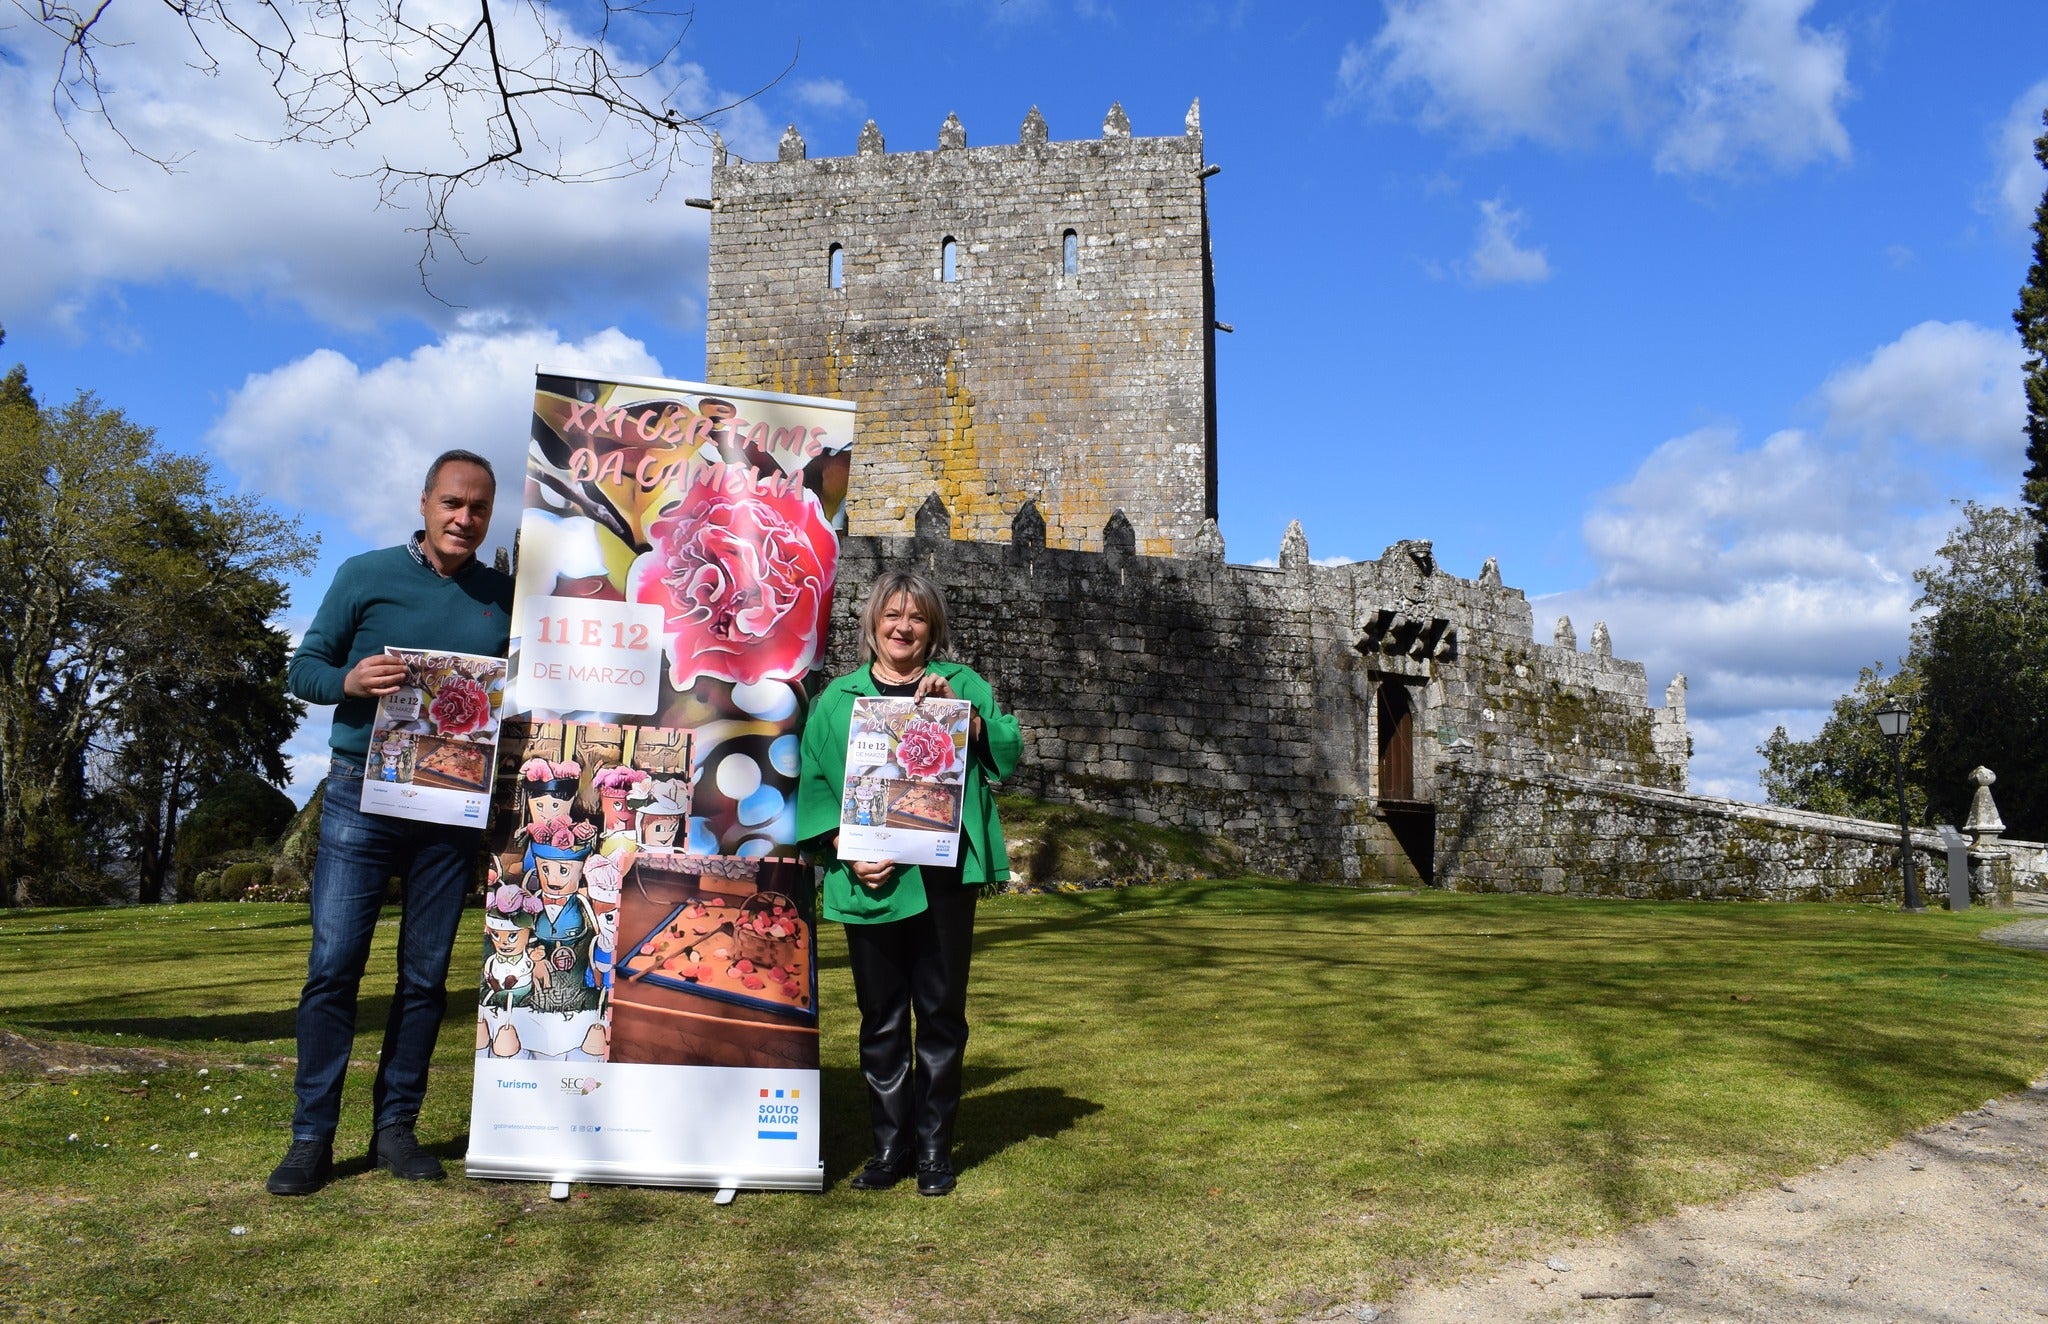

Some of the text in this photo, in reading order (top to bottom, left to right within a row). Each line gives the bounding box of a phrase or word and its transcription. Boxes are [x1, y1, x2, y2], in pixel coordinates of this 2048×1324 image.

[563, 401, 827, 458] XXI CERTAME
[569, 447, 805, 501] DA CAMELIA
[537, 616, 649, 651] 11 E 12
[533, 662, 646, 686] DE MARZO
[408, 696, 419, 706] 12
[857, 741, 866, 750] 11
[875, 742, 886, 751] 12
[497, 1079, 538, 1090] Turismo
[560, 1077, 584, 1090] SEC
[759, 1104, 799, 1114] SOUTO
[758, 1114, 799, 1124] MAIOR
